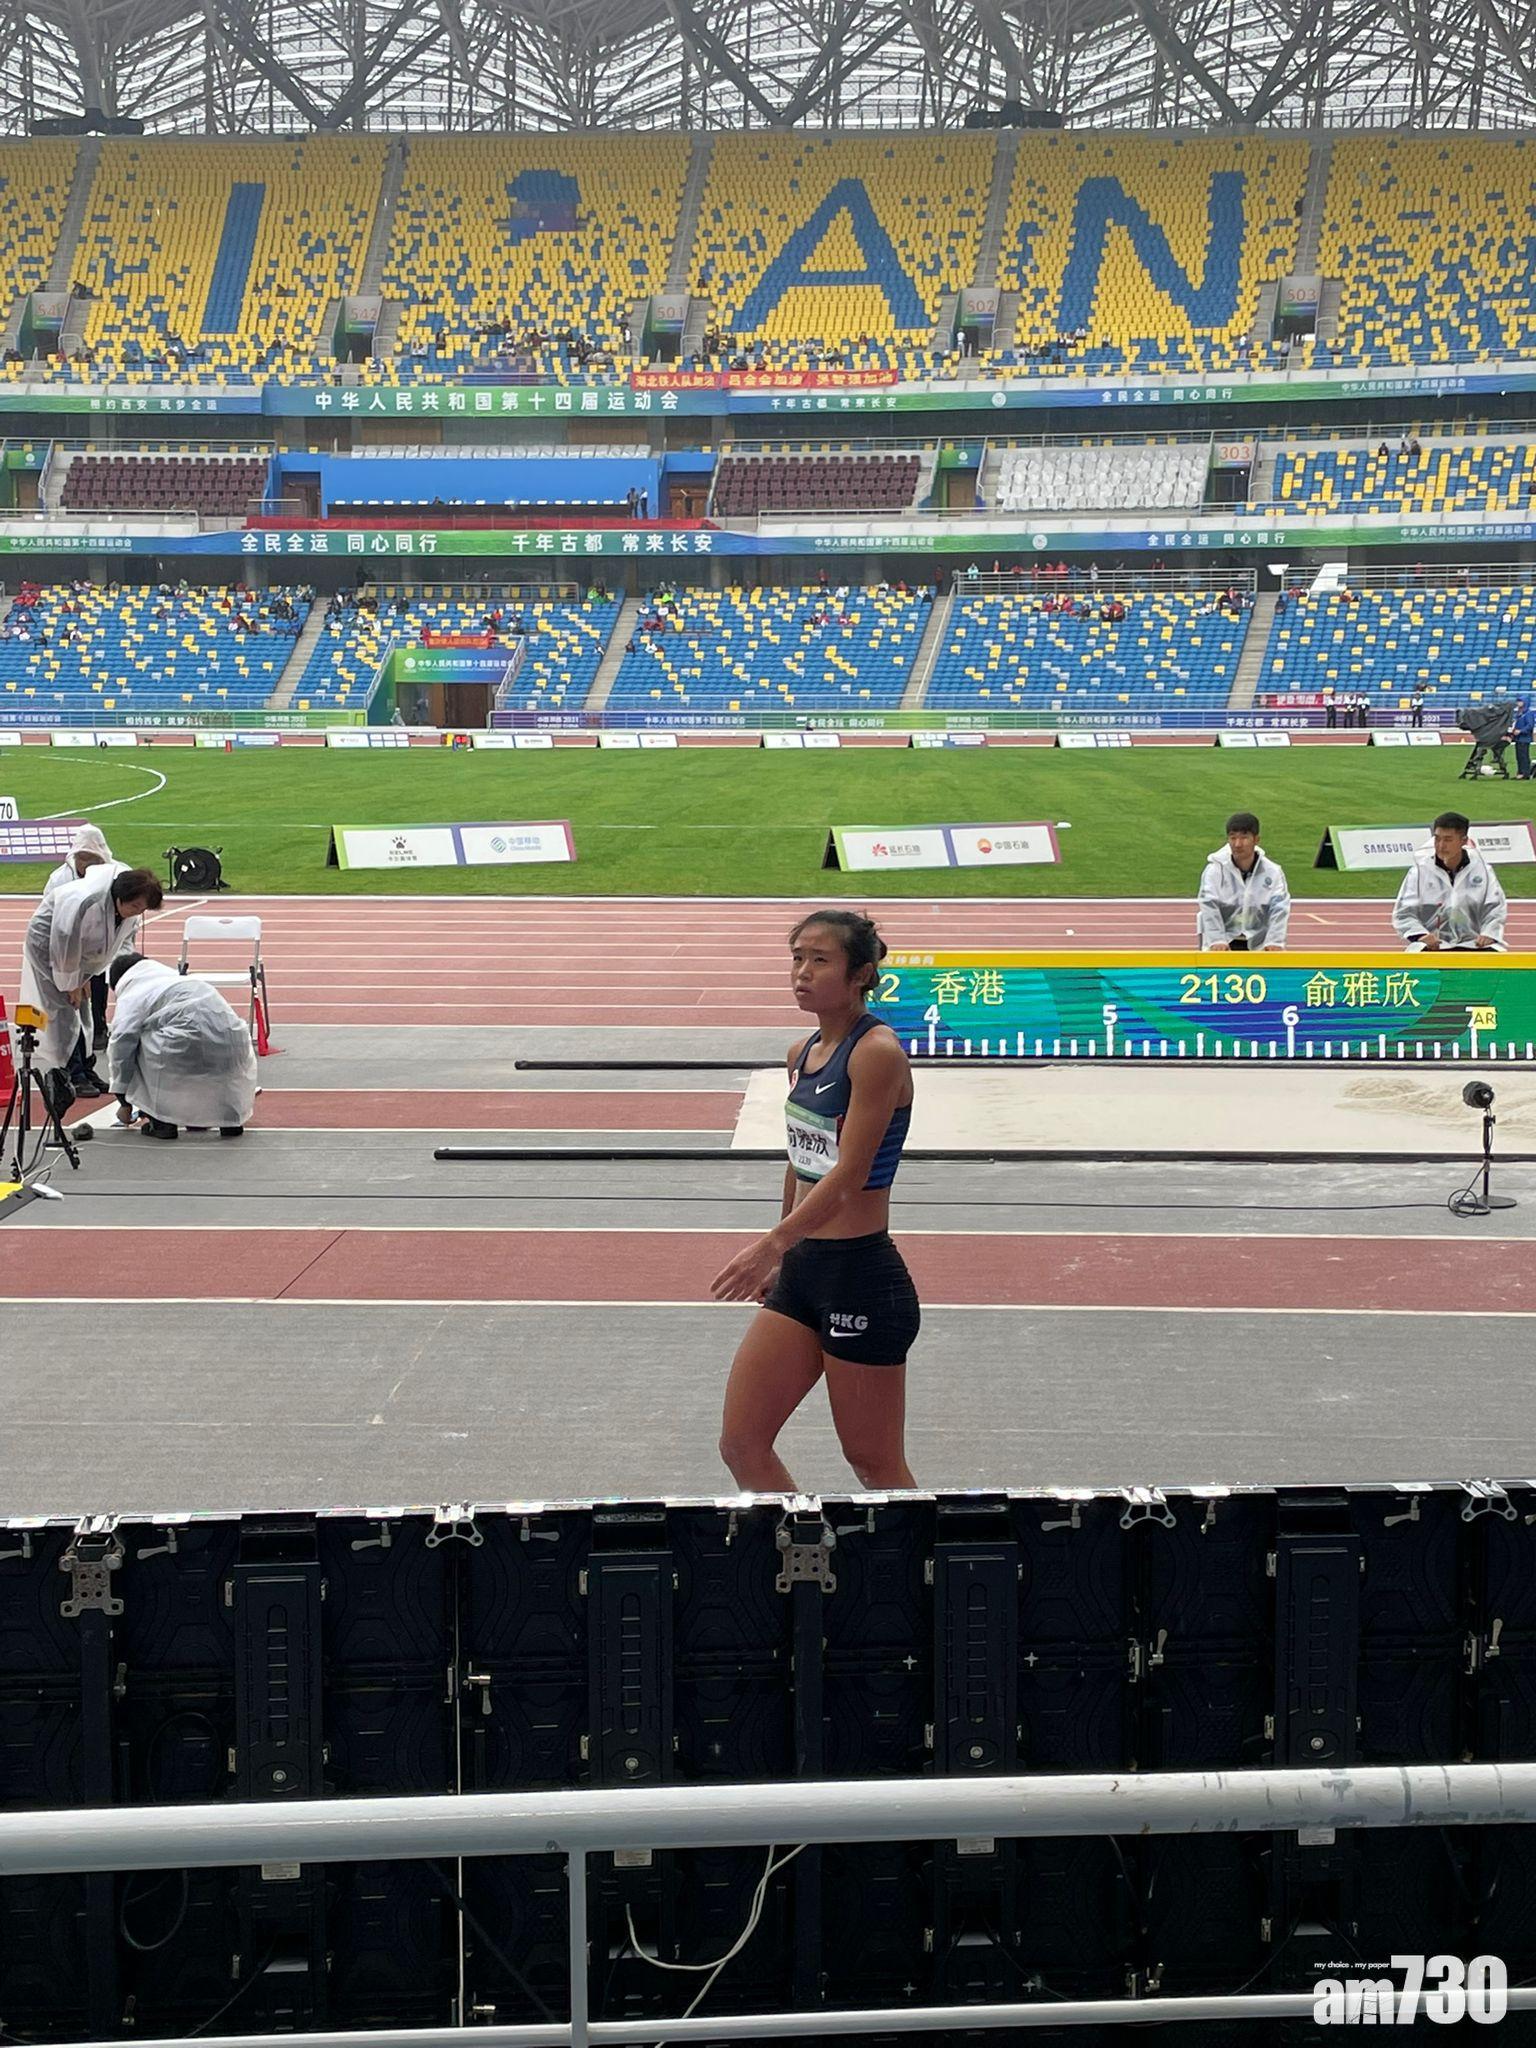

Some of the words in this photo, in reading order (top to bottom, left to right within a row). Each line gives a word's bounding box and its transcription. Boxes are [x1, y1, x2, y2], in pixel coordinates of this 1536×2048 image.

[1287, 288, 1317, 301] 503
[657, 306, 684, 319] 501
[967, 300, 995, 313] 502
[351, 307, 377, 320] 542
[1341, 378, 1466, 391] 中华人民共和国第十四届运动会
[315, 390, 679, 412] 中华人民共和国第十四届运动会
[1101, 389, 1160, 403] 全民全运
[1173, 387, 1234, 402] 同心同行
[771, 398, 827, 410] 千年古都
[840, 397, 897, 409] 常来长安
[1220, 446, 1250, 460] 303
[1400, 525, 1532, 538] 中华人民共和国第十四届运动会
[240, 533, 329, 553] 全民全运
[347, 533, 438, 553] 同心同行
[511, 533, 604, 553] 千年古都
[622, 533, 713, 553] 常来长安
[814, 537, 934, 548] 中华人民共和国第十四届运动会
[1147, 533, 1210, 547] 全民全运
[1223, 532, 1286, 546] 同心同行
[1363, 842, 1414, 855] SAMSUNG
[930, 969, 1006, 1005] 香港
[1179, 973, 1267, 1004] 2130
[1302, 970, 1421, 1008] 俞雅欣
[924, 1003, 941, 1025] 4
[1102, 1004, 1119, 1026] 5
[1282, 1005, 1299, 1027] 6
[1474, 1012, 1495, 1025] AR
[829, 1312, 869, 1331] HKG
